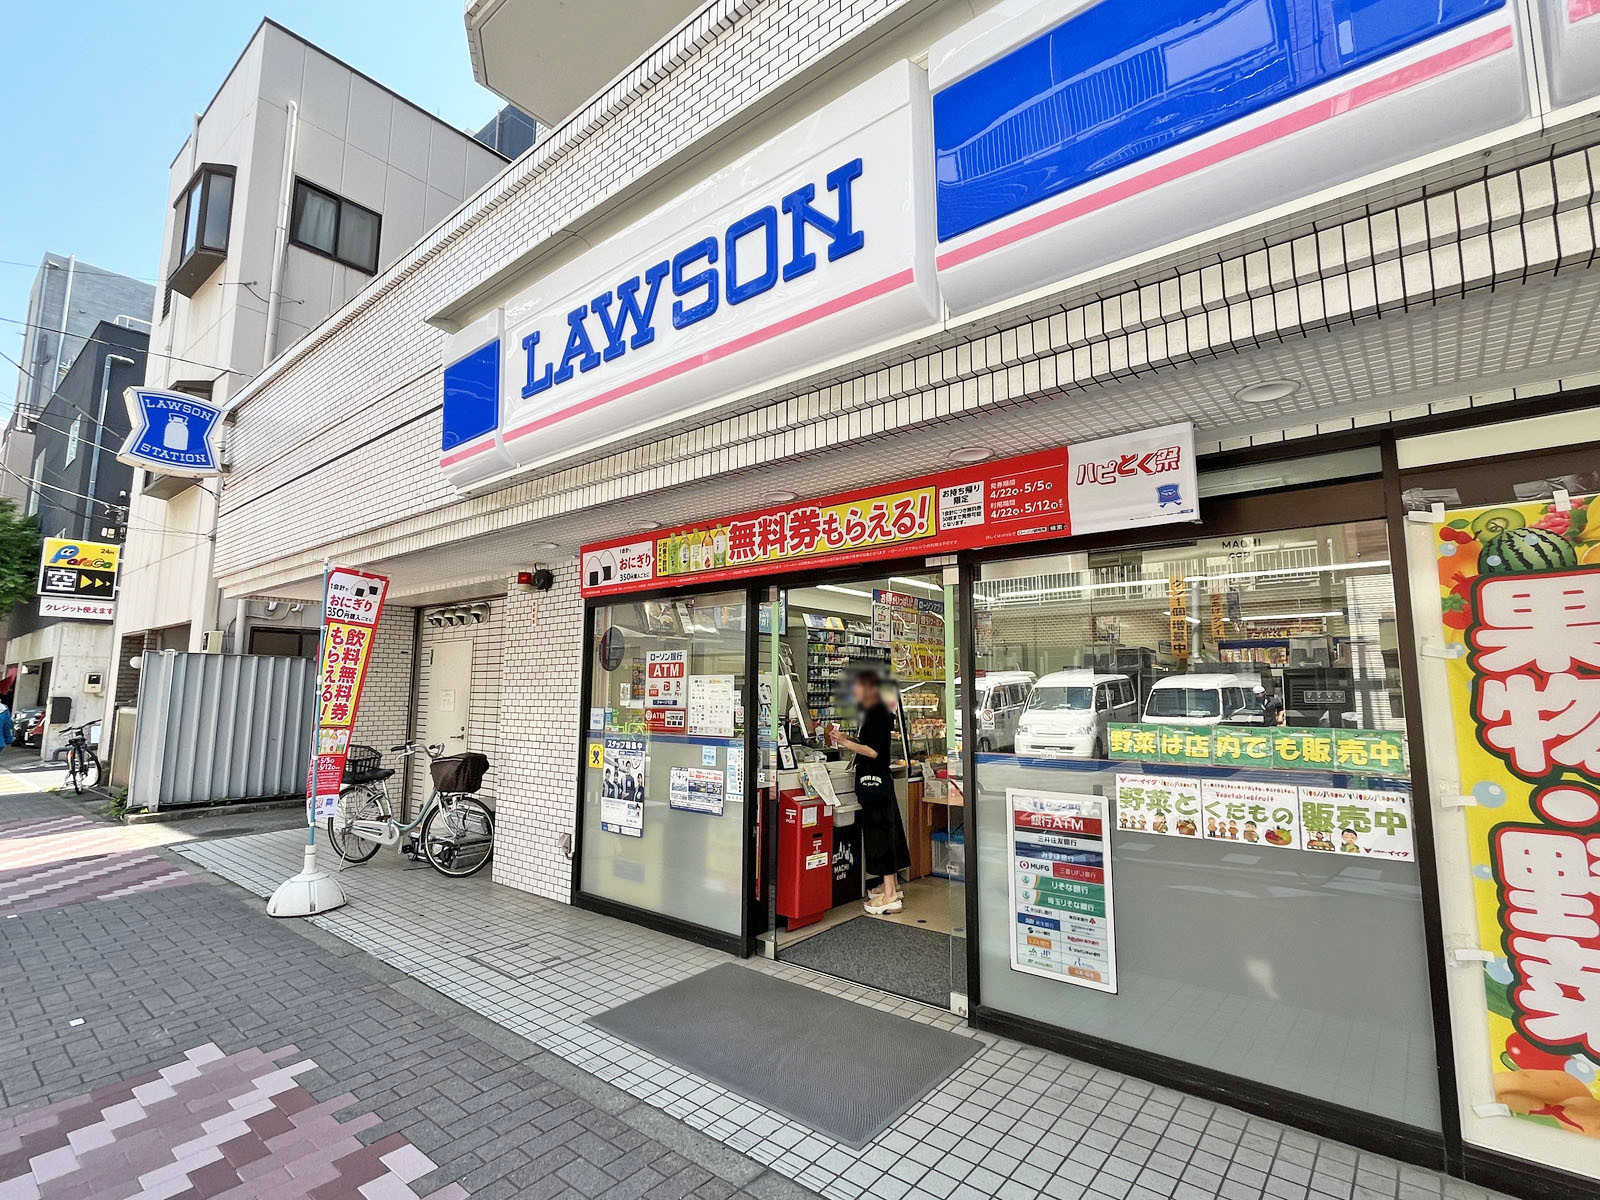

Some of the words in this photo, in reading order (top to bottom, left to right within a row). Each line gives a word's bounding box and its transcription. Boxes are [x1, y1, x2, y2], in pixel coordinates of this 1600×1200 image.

[521, 158, 864, 399] LAWSON
[145, 398, 213, 421] LAWSON
[140, 442, 207, 463] STATION
[1075, 445, 1181, 485] ハピとく祭
[942, 484, 981, 498] お持ち帰り
[953, 495, 969, 505] 限定
[619, 553, 651, 571] おにぎり
[45, 569, 78, 591] 空
[45, 603, 114, 615] クレジット使えます
[330, 594, 373, 612] おにぎり
[918, 600, 944, 613] ローソンアプ
[650, 652, 683, 661] ローソン銀行
[330, 629, 366, 722] 飲料無料券
[653, 663, 680, 677] ATM
[1110, 729, 1400, 767] 野菜は店内でも販売中
[1031, 814, 1084, 831] 銀行ATM
[1037, 835, 1077, 847] 三井住友銀行
[834, 863, 850, 873] MACHI
[1030, 862, 1050, 872] MUFG
[1051, 881, 1089, 894] りそな銀行
[1047, 897, 1095, 912] 埼玉りそな銀行
